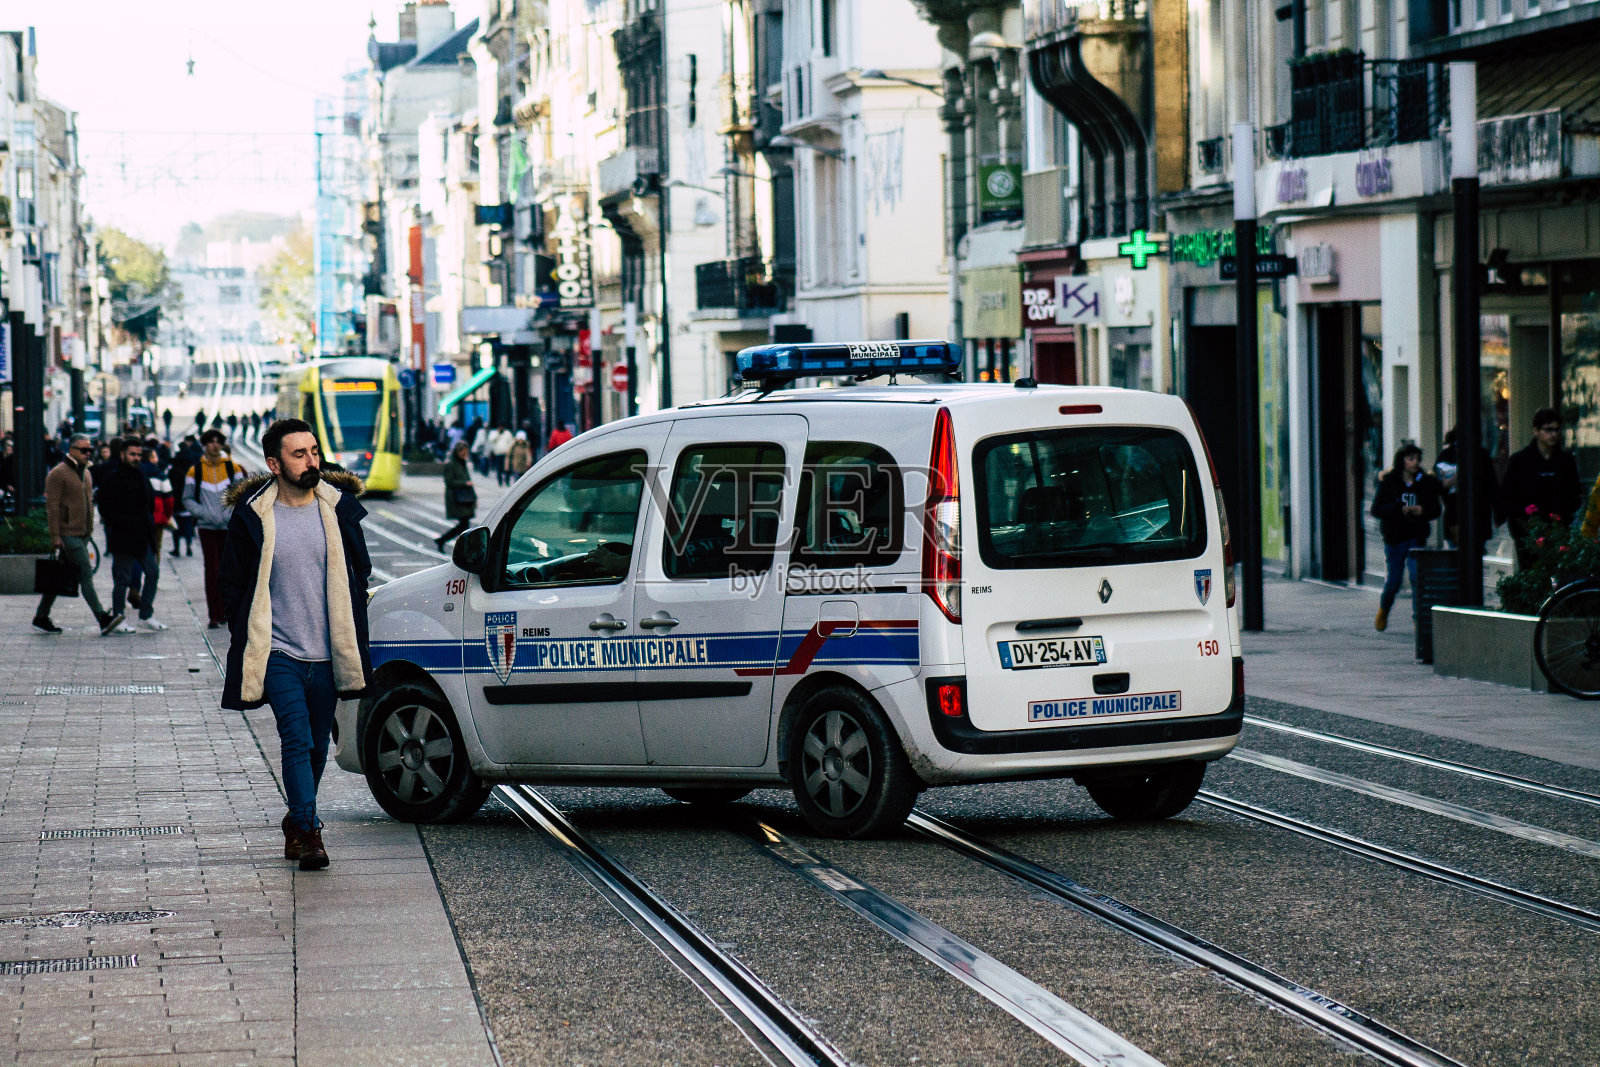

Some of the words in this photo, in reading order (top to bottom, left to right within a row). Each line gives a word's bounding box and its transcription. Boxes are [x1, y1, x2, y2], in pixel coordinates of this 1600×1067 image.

[848, 343, 898, 352] POLICE
[851, 351, 899, 359] MUNICIPALE
[445, 579, 466, 595] 150
[971, 585, 993, 595] REIMS
[487, 613, 515, 624] POLICE
[522, 627, 551, 638] REIMS
[538, 643, 597, 667] POLICE
[601, 638, 707, 667] MUNICIPALE
[1196, 639, 1219, 657] 150
[1032, 700, 1087, 719] POLICE
[1092, 694, 1177, 715] MUNICIPALE
